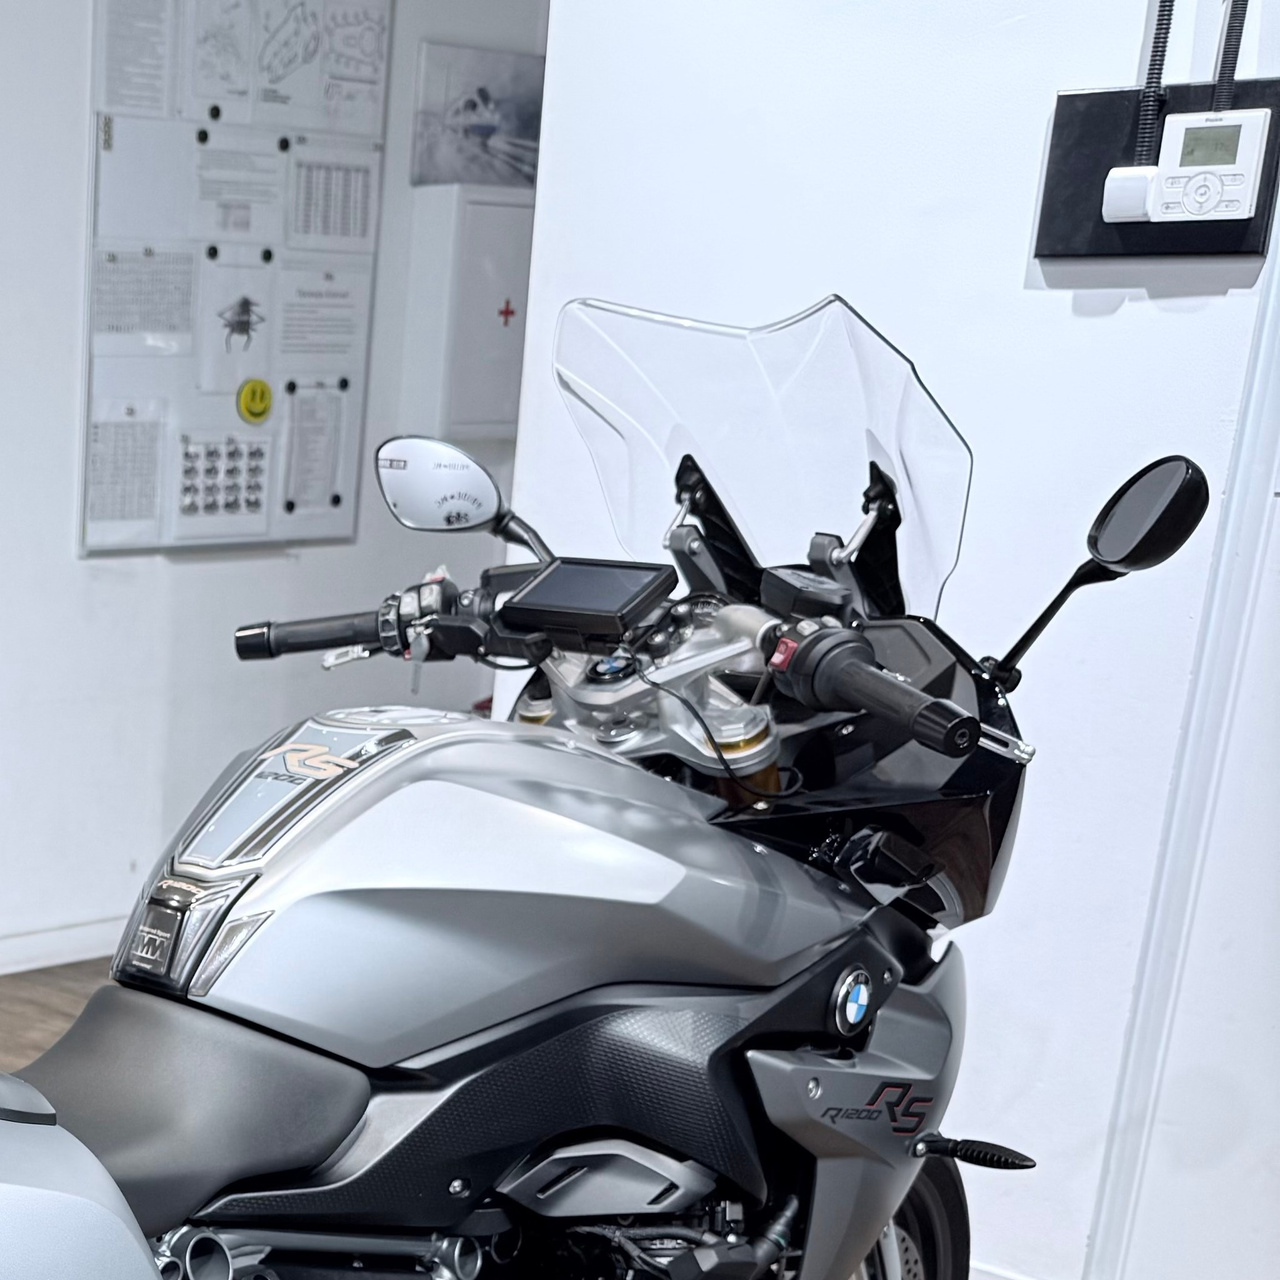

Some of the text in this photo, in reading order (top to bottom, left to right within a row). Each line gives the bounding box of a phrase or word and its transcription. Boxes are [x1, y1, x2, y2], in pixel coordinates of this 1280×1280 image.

[257, 743, 360, 780] RS
[820, 1081, 934, 1136] R1200 RS
